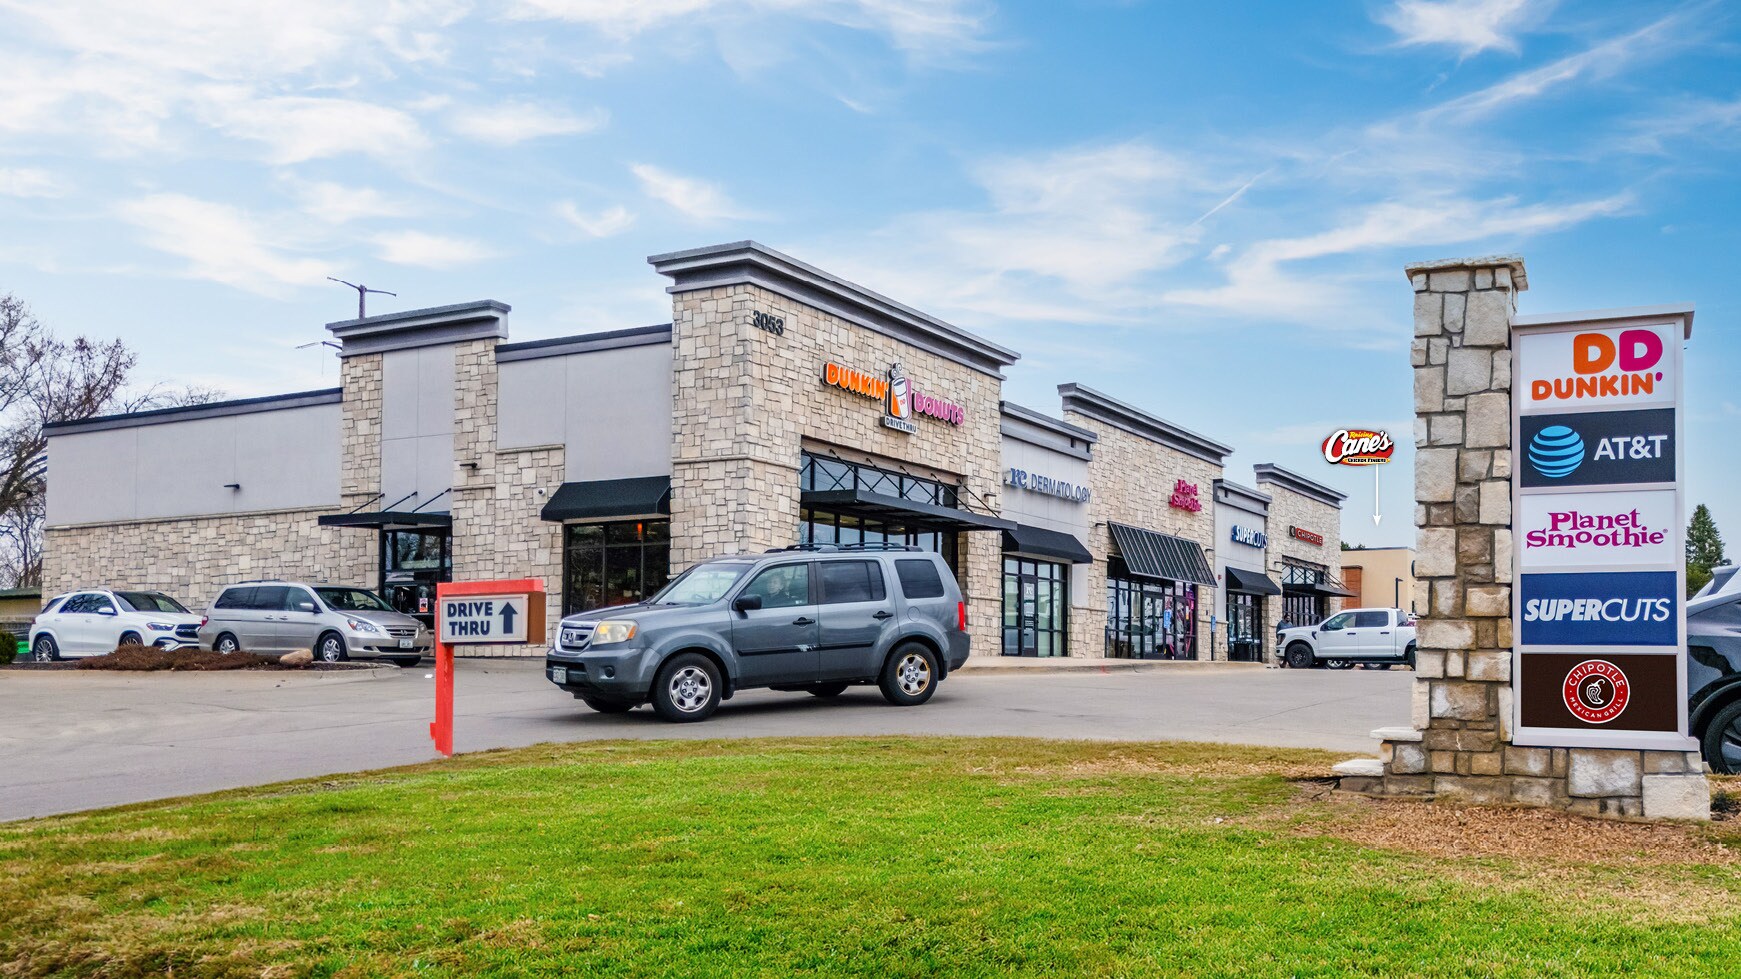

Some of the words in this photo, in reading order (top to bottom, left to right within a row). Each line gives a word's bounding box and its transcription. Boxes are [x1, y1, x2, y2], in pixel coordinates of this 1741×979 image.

[753, 310, 784, 336] 3053
[1573, 329, 1663, 375] DD
[827, 362, 889, 400] DUNKIN'
[914, 391, 964, 425] DONUTS
[1531, 372, 1663, 401] DUNKIN'
[886, 417, 903, 429] DRIVE
[902, 420, 917, 433] THRU
[1593, 435, 1668, 461] AT&T
[1031, 473, 1092, 504] DERMATOLOGY
[1548, 508, 1642, 532] Planet
[1236, 525, 1268, 549] SUPERCUTS
[1297, 530, 1323, 544] CHIPOTLE
[447, 602, 493, 618] DRIVE
[1524, 598, 1671, 622] SUPERCUTS
[449, 620, 490, 636] THRU
[1568, 664, 1625, 688] CHIPOTLE
[1570, 696, 1602, 718] MEXICAN
[1604, 698, 1624, 716] GRILL
